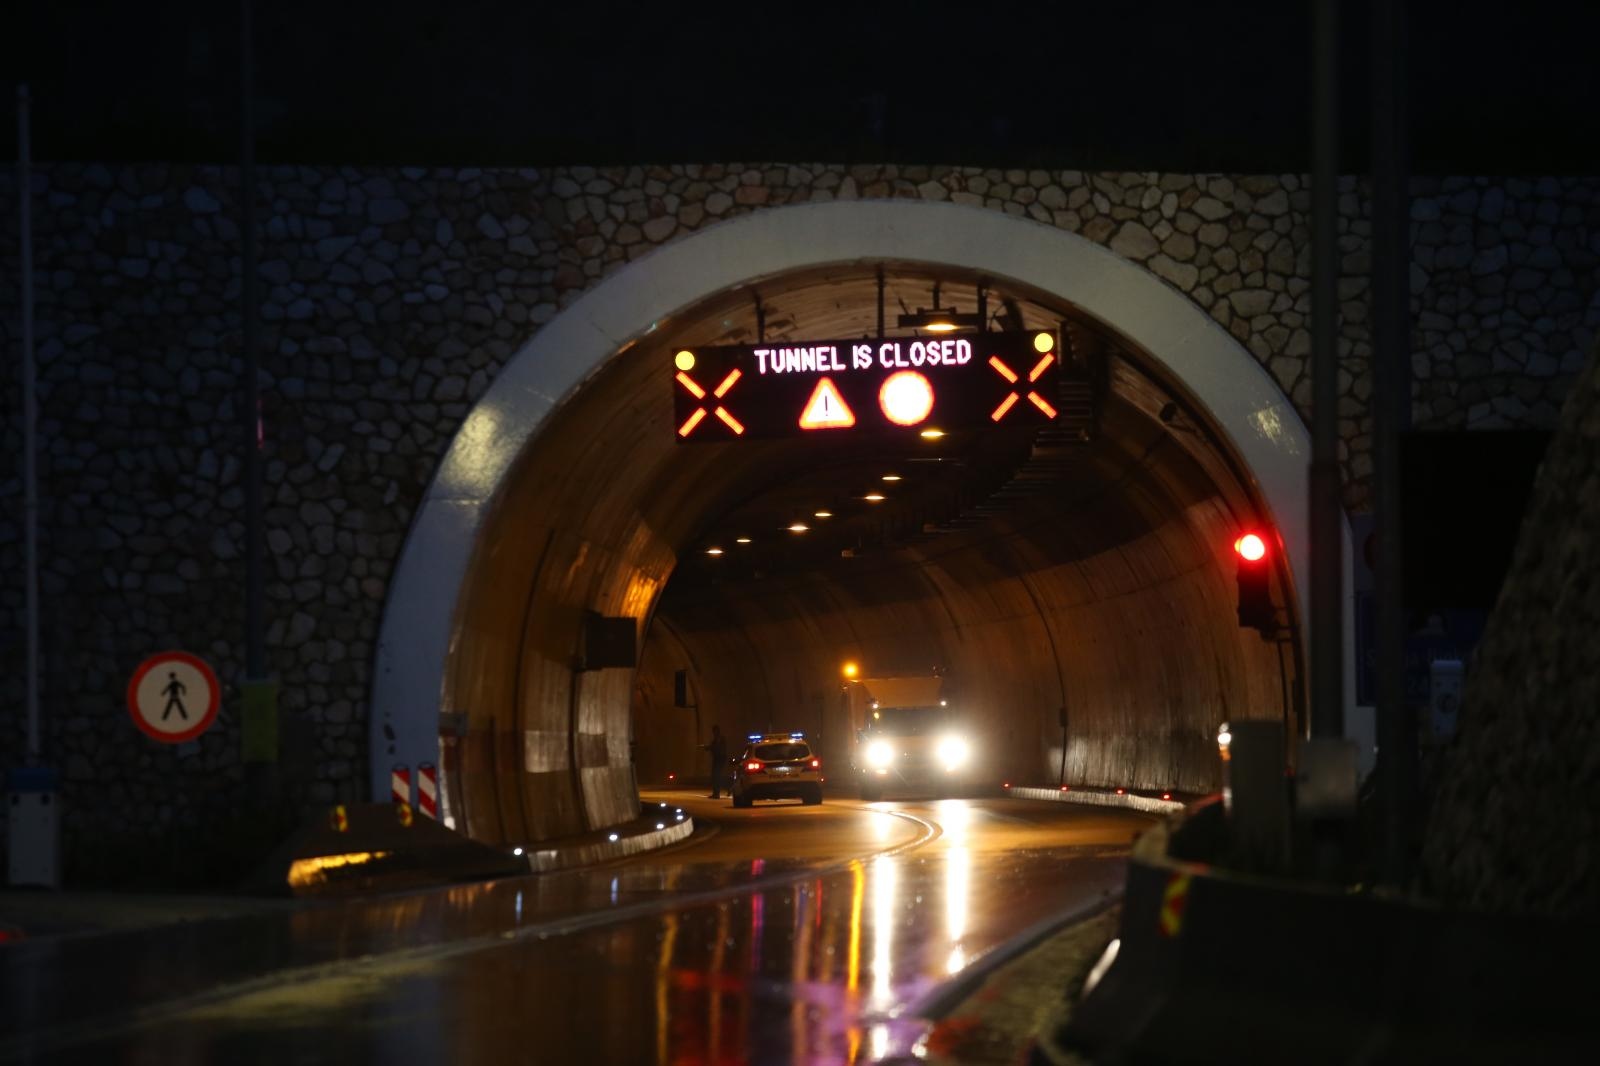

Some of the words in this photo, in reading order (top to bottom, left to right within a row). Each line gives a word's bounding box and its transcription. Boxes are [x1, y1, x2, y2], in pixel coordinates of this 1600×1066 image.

[754, 346, 847, 374] TUNNEL
[852, 344, 873, 369] IS
[879, 339, 972, 368] CLOSED
